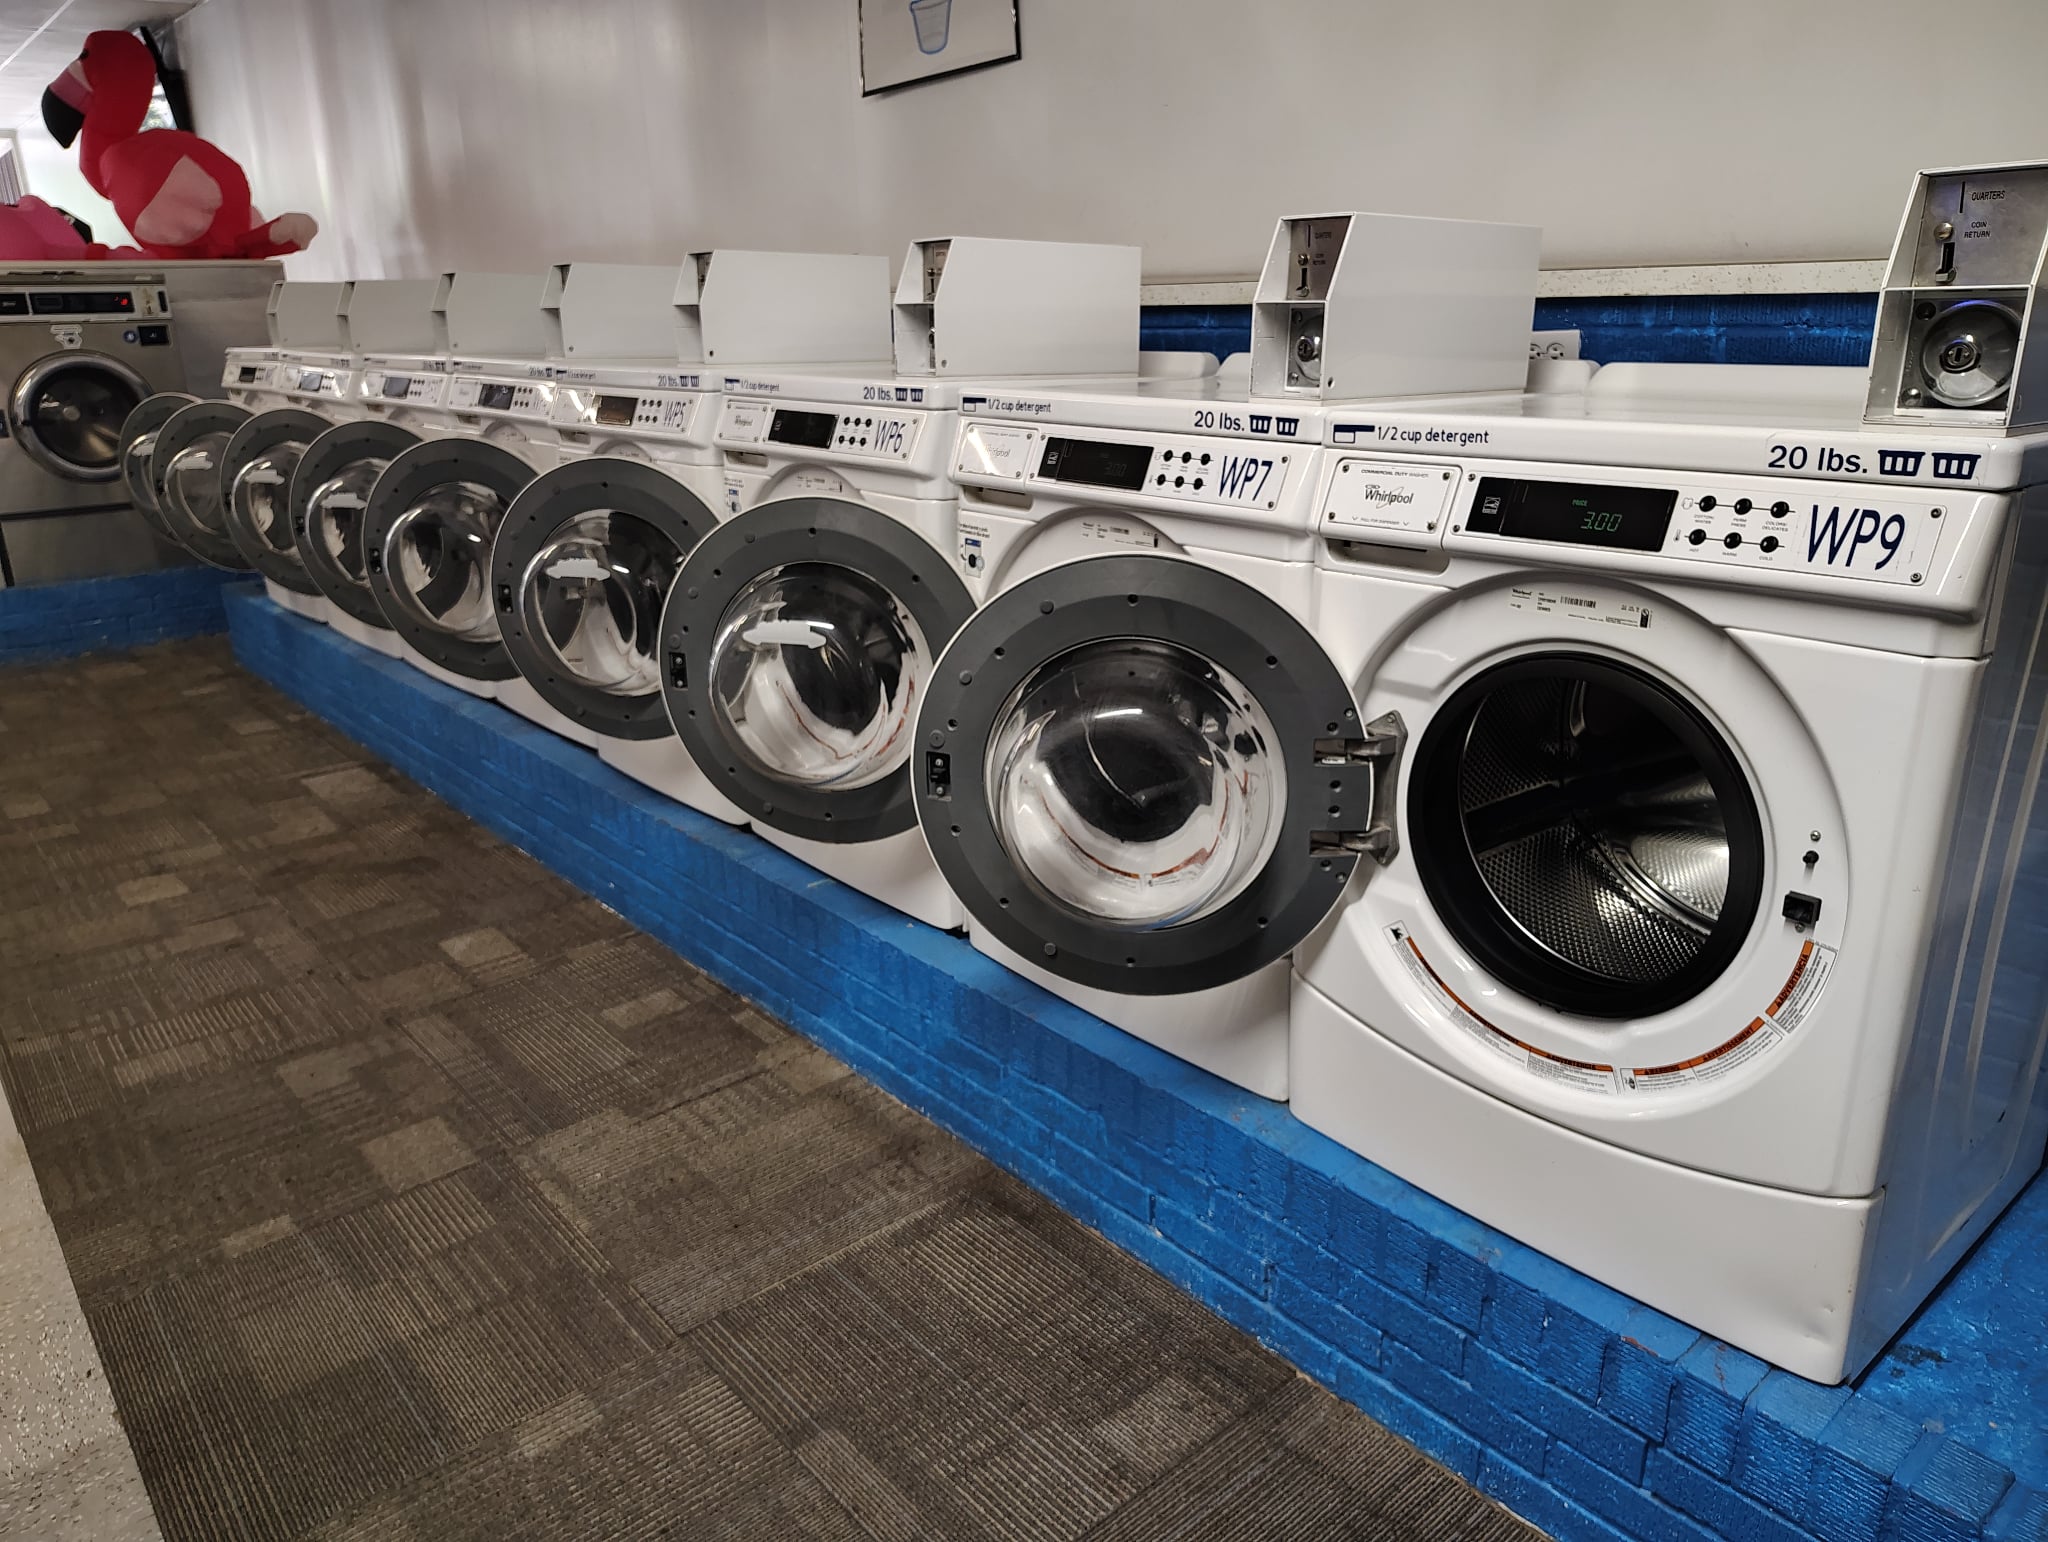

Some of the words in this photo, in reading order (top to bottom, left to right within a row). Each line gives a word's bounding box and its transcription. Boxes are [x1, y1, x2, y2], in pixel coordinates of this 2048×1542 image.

[1971, 191, 2005, 201] QUARTERS
[863, 386, 876, 400] 20
[878, 387, 894, 401] lbs.
[663, 400, 686, 428] WP5
[988, 398, 1000, 411] 1/2
[1001, 402, 1014, 414] cup
[1015, 400, 1052, 415] detergent
[1194, 410, 1215, 429] 20
[1219, 412, 1245, 432] lbs.
[874, 419, 907, 454] WP6
[1377, 426, 1398, 441] 1/2
[1400, 429, 1422, 444] cup
[1425, 427, 1490, 447] detergent
[1768, 445, 1808, 470] 20
[1817, 447, 1868, 474] lbs.
[1218, 455, 1274, 502] WP7
[1364, 488, 1415, 506] Whirlpool
[1580, 511, 1623, 533] 3.00
[1807, 504, 1906, 571] WP9
